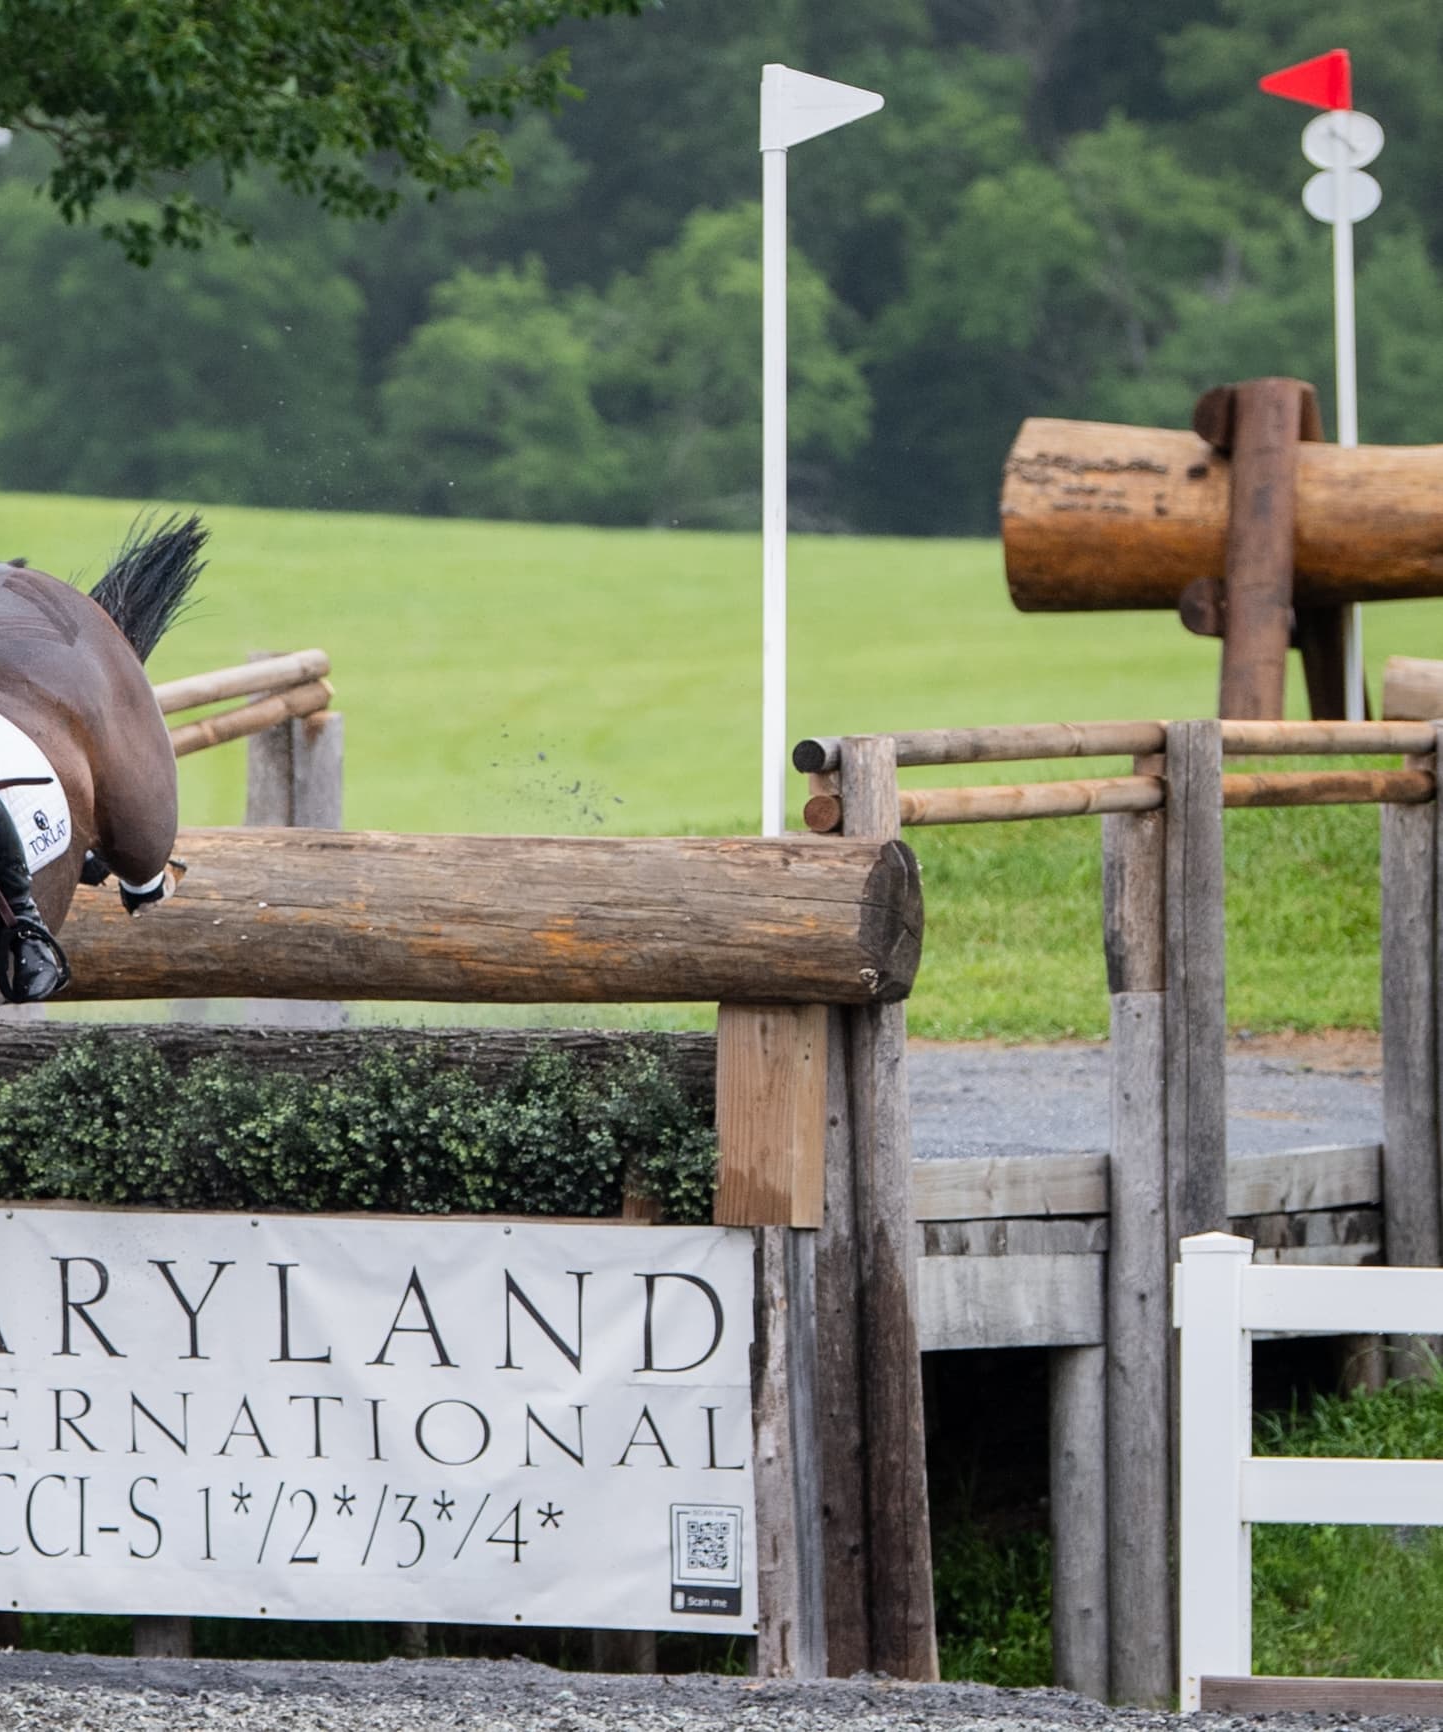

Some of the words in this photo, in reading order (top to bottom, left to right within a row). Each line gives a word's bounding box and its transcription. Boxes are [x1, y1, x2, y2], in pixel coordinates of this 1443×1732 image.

[29, 819, 67, 856] TOKLAT
[687, 1596, 710, 1608] Scan
[712, 1599, 728, 1608] me
